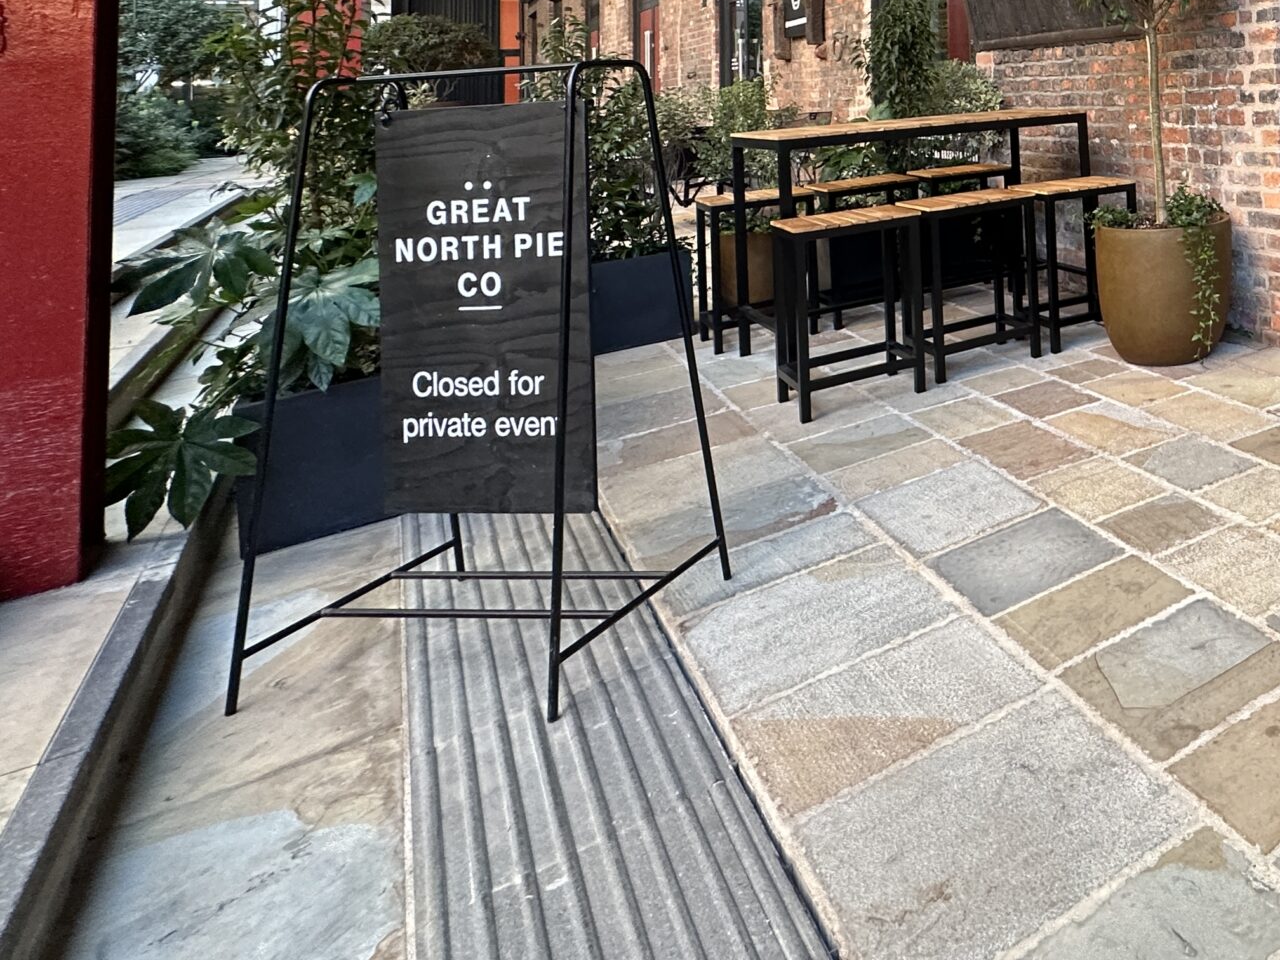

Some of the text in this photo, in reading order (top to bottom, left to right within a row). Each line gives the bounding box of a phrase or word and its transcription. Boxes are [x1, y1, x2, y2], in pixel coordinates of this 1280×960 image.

[426, 196, 531, 226] GREAT
[394, 231, 564, 263] NORTH PIE
[457, 270, 502, 298] CO
[412, 369, 545, 398] Closed for
[402, 411, 558, 444] private even
